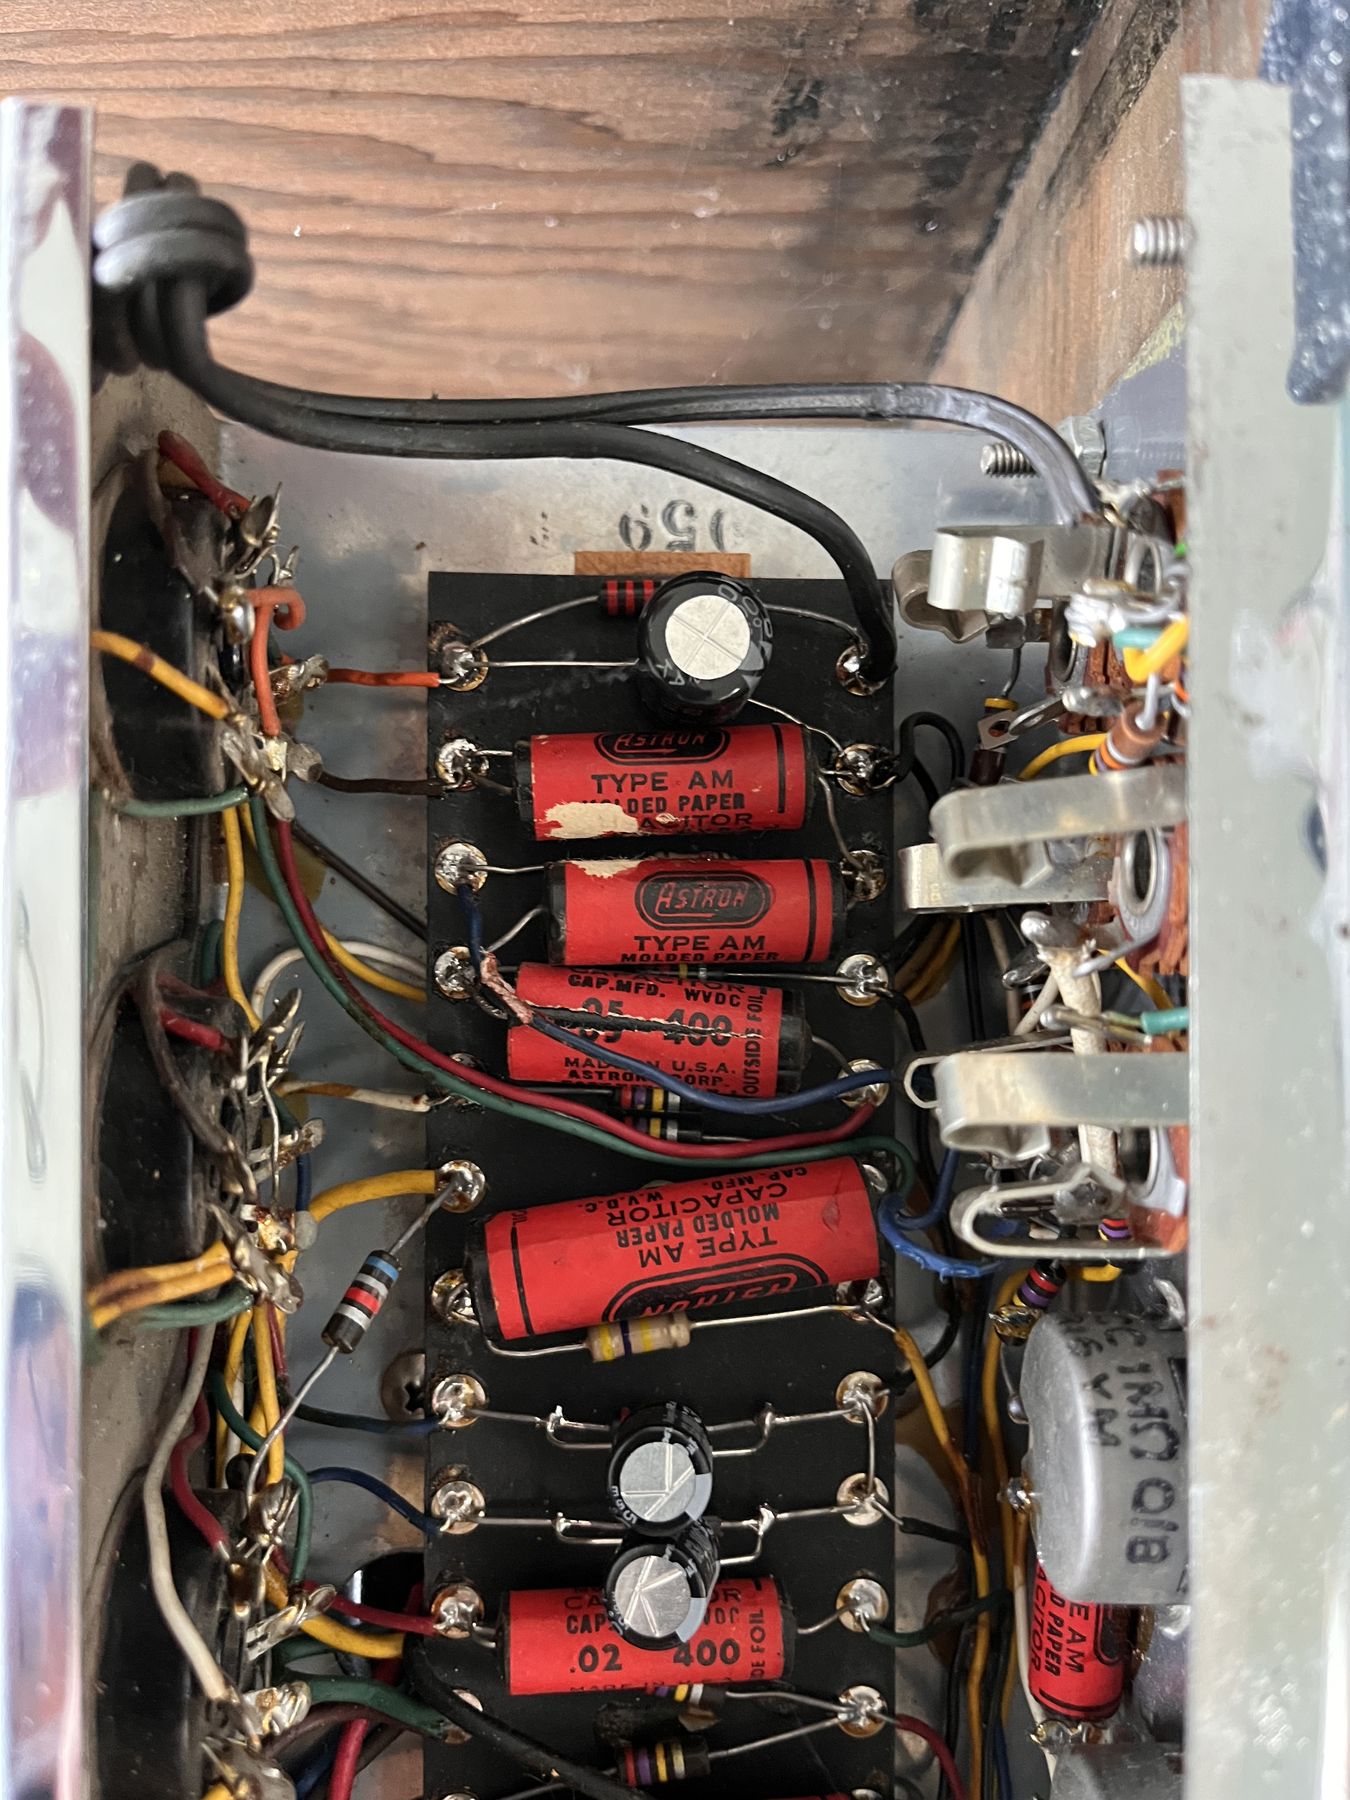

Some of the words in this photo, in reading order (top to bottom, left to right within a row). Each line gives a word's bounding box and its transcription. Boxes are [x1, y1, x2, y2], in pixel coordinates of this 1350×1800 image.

[591, 771, 669, 794] TYPE
[688, 769, 733, 790] AM
[678, 792, 745, 812] PAPER
[621, 952, 705, 963] MOLDED
[713, 951, 780, 962] PAPER
[634, 935, 710, 952] TYPE
[719, 935, 766, 951] AM
[684, 987, 741, 1007] WVDC
[746, 992, 764, 1022] FOIL
[663, 1008, 733, 1047] 400
[672, 1060, 736, 1074] U.S.A.
[743, 1027, 761, 1094] OUTSIDE
[702, 1174, 754, 1191] MFD.
[606, 1182, 788, 1227] CAPACITOR
[693, 1202, 780, 1235] MOLDED
[616, 1219, 684, 1248] PAPER
[699, 1227, 778, 1258] TYPE
[637, 1243, 684, 1269] AM
[749, 1608, 766, 1653] FOIL
[1031, 1566, 1048, 1672] ACITOR
[570, 1643, 623, 1673] .02
[673, 1638, 741, 1666] 400
[1044, 1611, 1064, 1677] PAPER
[1065, 1626, 1086, 1673] AM
